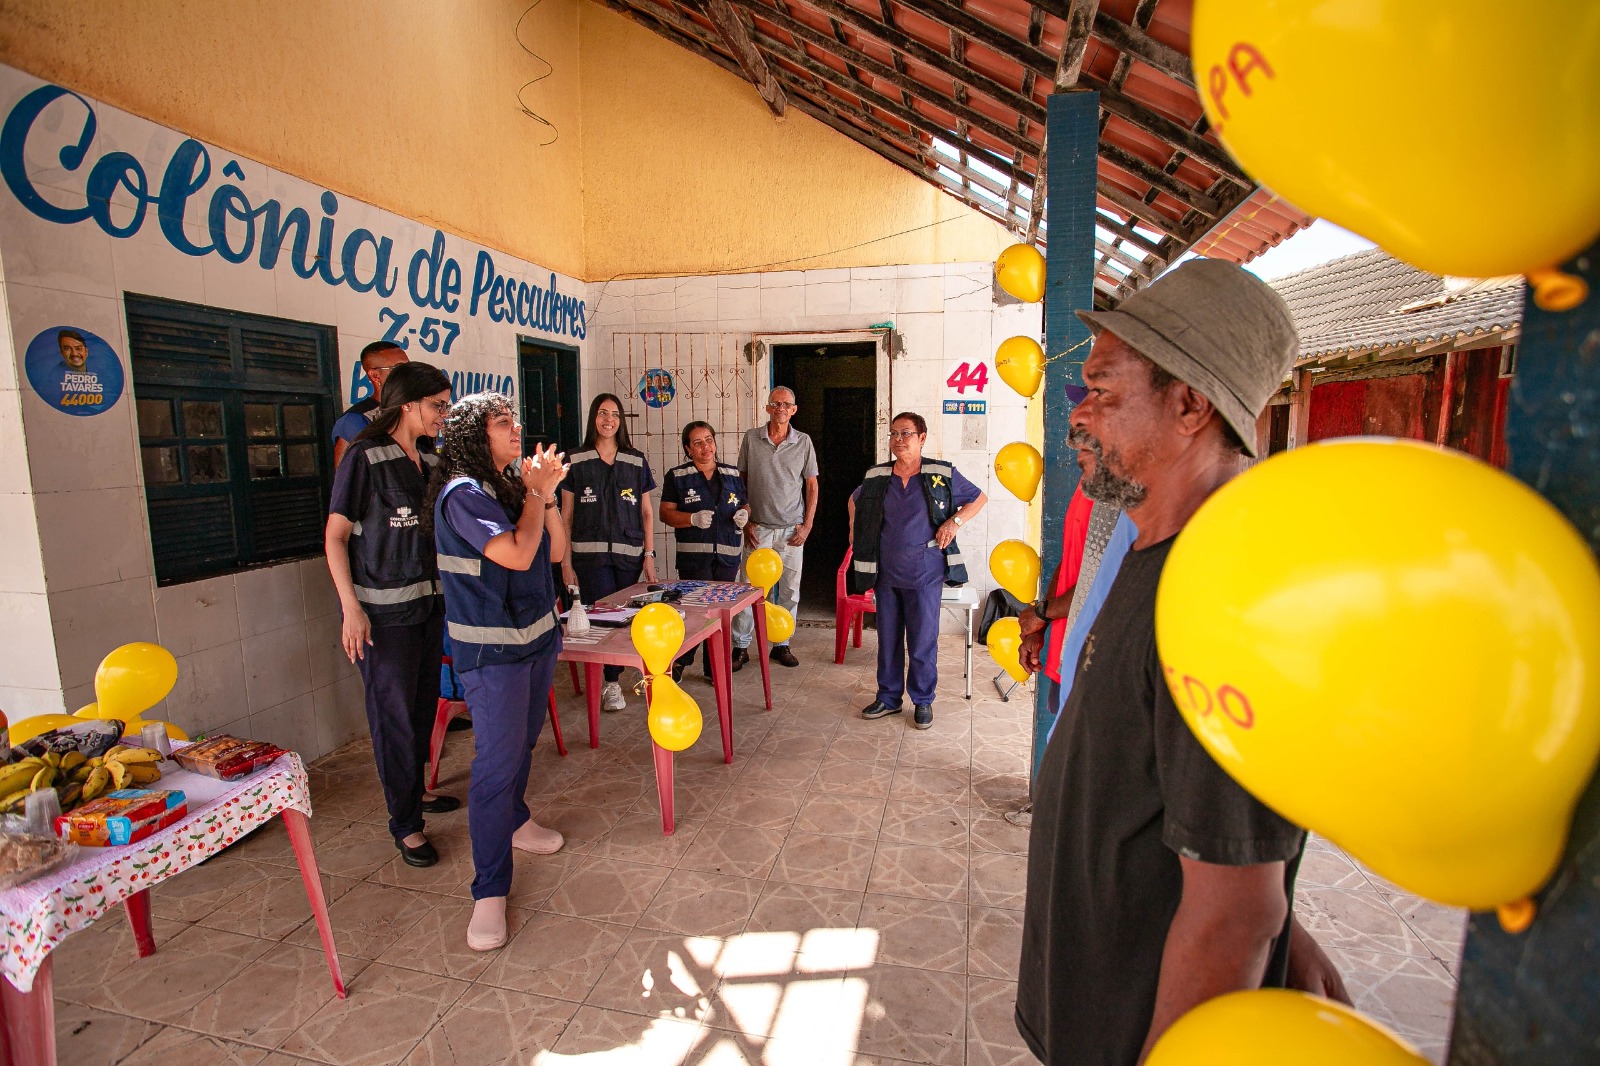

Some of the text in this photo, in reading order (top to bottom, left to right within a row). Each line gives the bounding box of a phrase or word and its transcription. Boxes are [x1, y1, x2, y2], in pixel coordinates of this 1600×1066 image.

[1209, 43, 1274, 135] PA
[0, 85, 587, 341] Colônia de Pescadores
[379, 307, 461, 355] Z-57
[60, 382, 103, 393] TAVARES
[64, 373, 98, 384] PEDRO
[946, 361, 989, 395] 44
[60, 393, 103, 407] 44000
[967, 403, 985, 412] 1111
